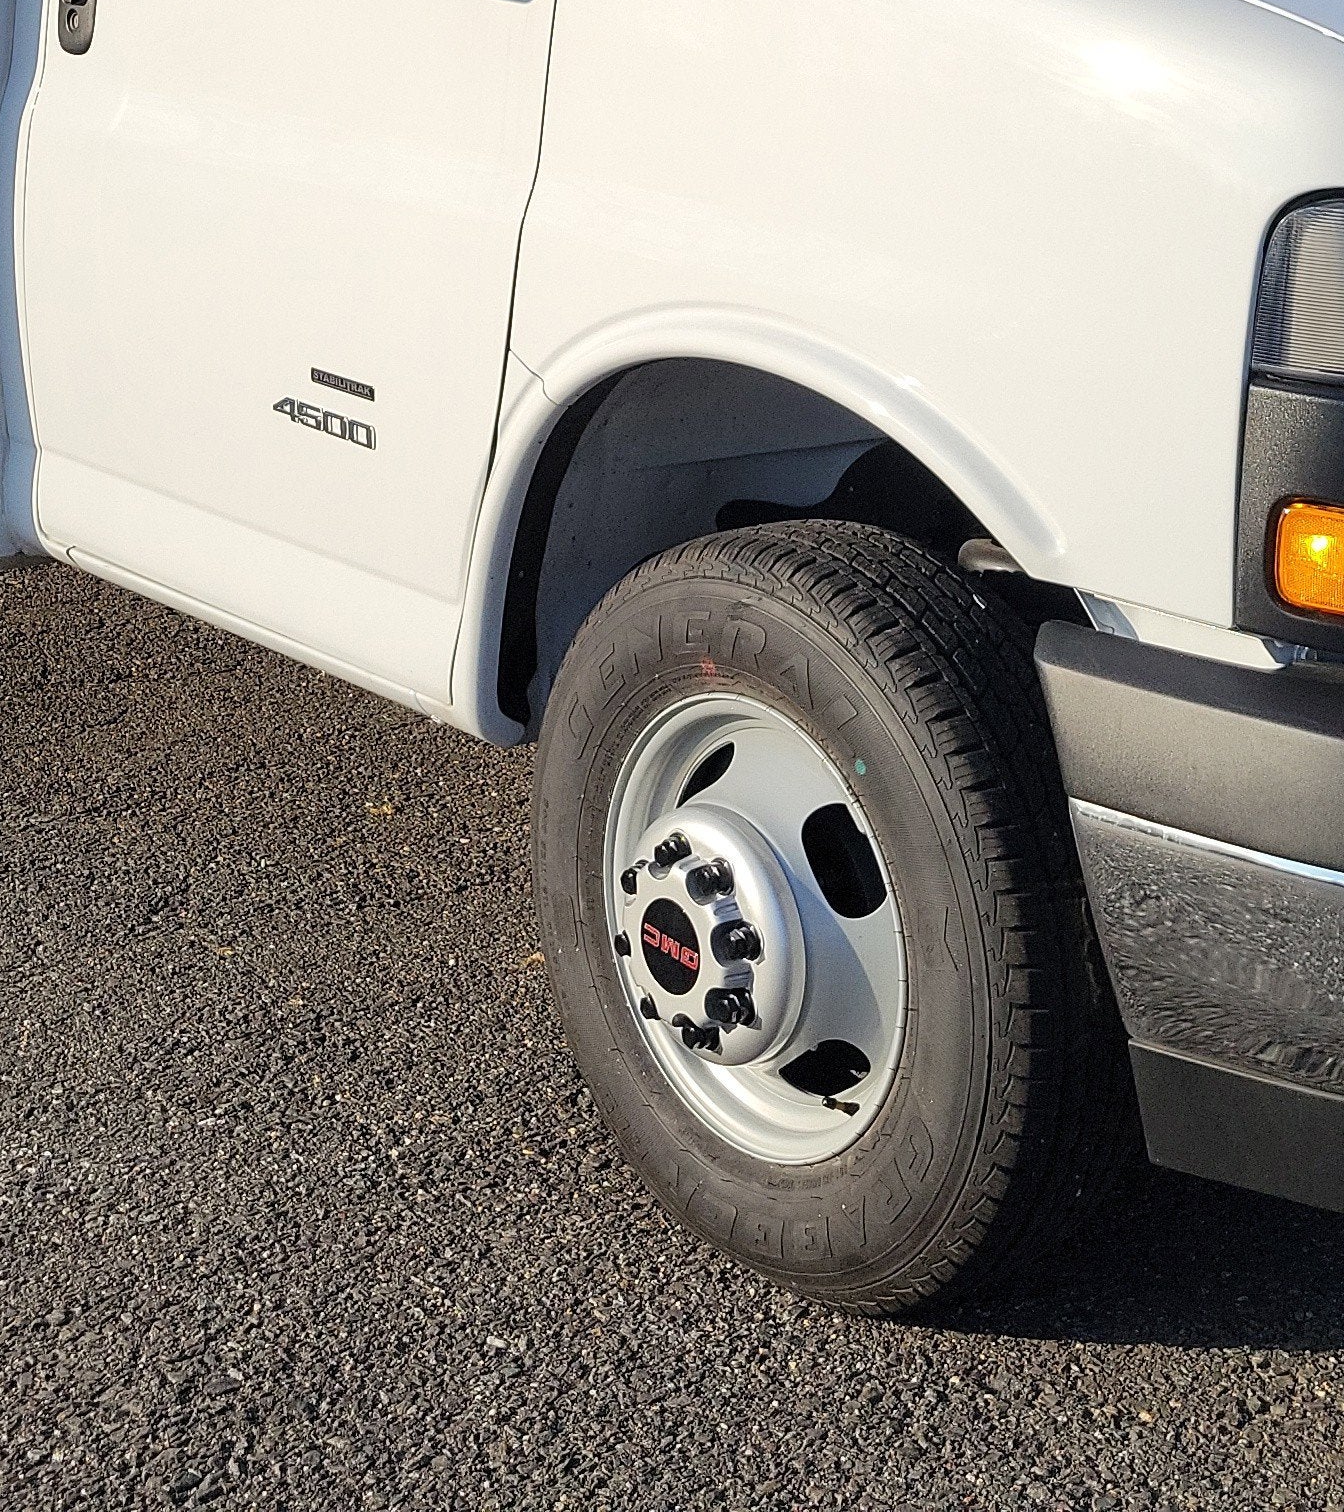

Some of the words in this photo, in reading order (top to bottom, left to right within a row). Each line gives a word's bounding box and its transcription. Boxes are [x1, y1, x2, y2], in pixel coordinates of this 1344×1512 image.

[312, 370, 372, 397] STABILITRAK
[272, 396, 377, 451] 4500
[566, 609, 860, 760] GENERAL
[643, 922, 699, 971] GMC
